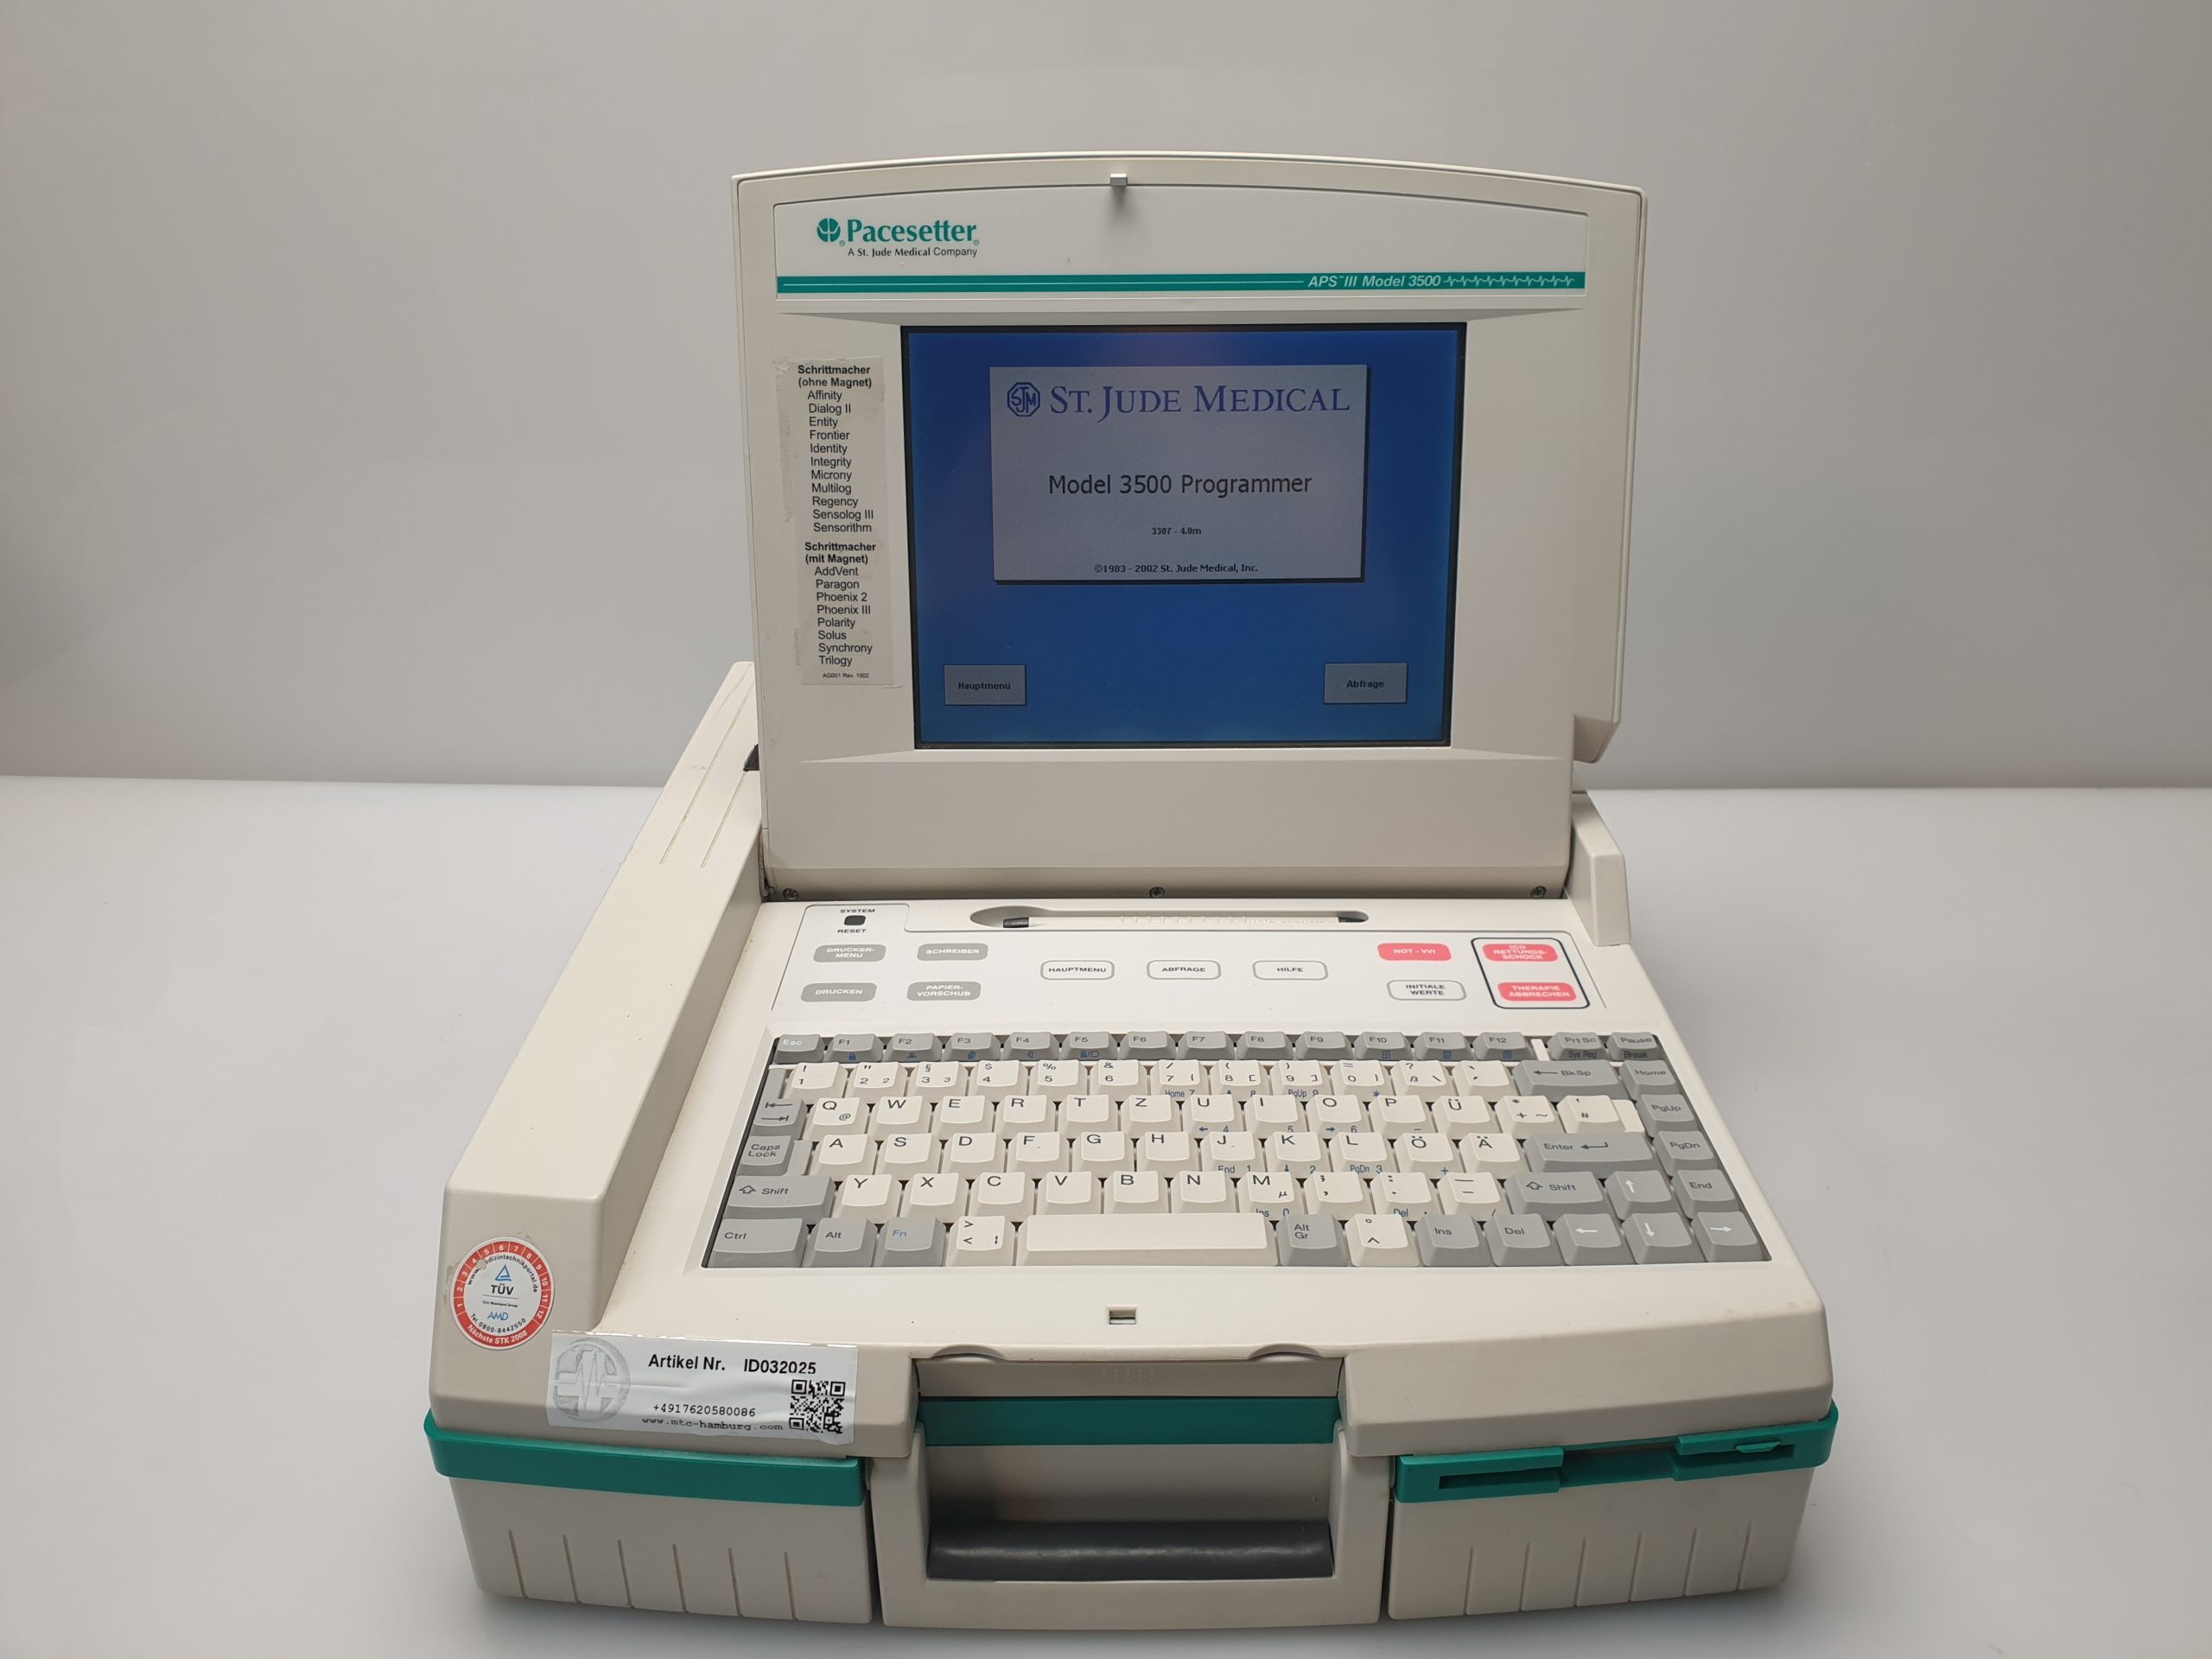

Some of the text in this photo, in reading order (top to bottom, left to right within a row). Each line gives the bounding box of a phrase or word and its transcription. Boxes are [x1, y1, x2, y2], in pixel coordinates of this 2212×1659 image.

[847, 219, 976, 242] Pacesetter
[848, 247, 978, 257] A St. Jude Medical Company
[1362, 275, 1406, 287] Model
[1408, 275, 1441, 287] 3500
[798, 365, 870, 374] Schrittmacher
[798, 377, 872, 389] (ohne Magnet)
[808, 391, 842, 402] Affinity
[1050, 385, 1351, 423] ST. JUDE MEDICAL
[809, 404, 851, 416] Dialog II
[809, 416, 838, 429] Entity
[810, 429, 850, 440] Frontier
[810, 443, 848, 455] Identity
[810, 456, 852, 468] Integrity
[811, 470, 852, 482] Microny
[811, 483, 852, 495] Multilog
[1049, 474, 1313, 499] Model 3500 Programmer
[812, 496, 859, 508] Regency
[812, 509, 874, 522] Sensolog III
[813, 523, 872, 532] Sensorithm
[1151, 527, 1172, 536] 3307
[804, 542, 876, 551] Schrittmacher
[805, 554, 868, 565] (mit Magnet)
[814, 567, 859, 576] AddVent
[1135, 564, 1159, 573] 2002
[1160, 564, 1173, 573] St.
[1176, 563, 1198, 573] Jude
[1200, 563, 1238, 574] Medical,
[1241, 563, 1259, 572] Inc.
[816, 580, 860, 591] Paragon
[817, 592, 868, 602] Phoenix 2
[817, 605, 871, 614] Phoenix III
[817, 617, 855, 629] Polarity
[817, 630, 847, 640] Solus
[818, 643, 873, 655] Synchrony
[818, 655, 853, 667] Trilogy
[1346, 680, 1384, 689] Abfrage
[823, 1101, 837, 1111] Q
[887, 1099, 907, 1109] W
[948, 1099, 962, 1109] E
[1011, 1098, 1025, 1108] R
[1135, 1098, 1148, 1108] Z
[1197, 1098, 1211, 1108] U
[1385, 1098, 1397, 1107] P
[1448, 1099, 1462, 1111] Ü
[1651, 1104, 1681, 1113] PgUp
[829, 1138, 844, 1148] A
[893, 1137, 907, 1147] S
[958, 1136, 973, 1147] D
[1086, 1134, 1102, 1144] G
[1152, 1134, 1165, 1144] H
[1281, 1135, 1296, 1145] K
[1411, 1136, 1427, 1148] Ö
[1477, 1135, 1493, 1149] Ä
[1669, 1141, 1701, 1150] PgDn
[919, 1177, 936, 1188] X
[987, 1176, 1002, 1187] C
[1121, 1174, 1135, 1185] B
[1187, 1175, 1201, 1185] N
[1253, 1175, 1271, 1185] M
[1548, 1183, 1577, 1192] Shift
[724, 1231, 747, 1240] Ctrl
[1434, 1227, 1452, 1236] Ins
[1504, 1227, 1525, 1236] Del
[490, 1283, 514, 1295] TÜV
[470, 1313, 480, 1325] Tel.
[487, 1312, 509, 1321] AMD
[511, 1330, 528, 1343] 2008
[648, 1354, 817, 1375] Artikel Nr. ID032025
[652, 1403, 756, 1417] +4917620580086
[641, 1417, 784, 1431] www.mtc-hamburg.com
